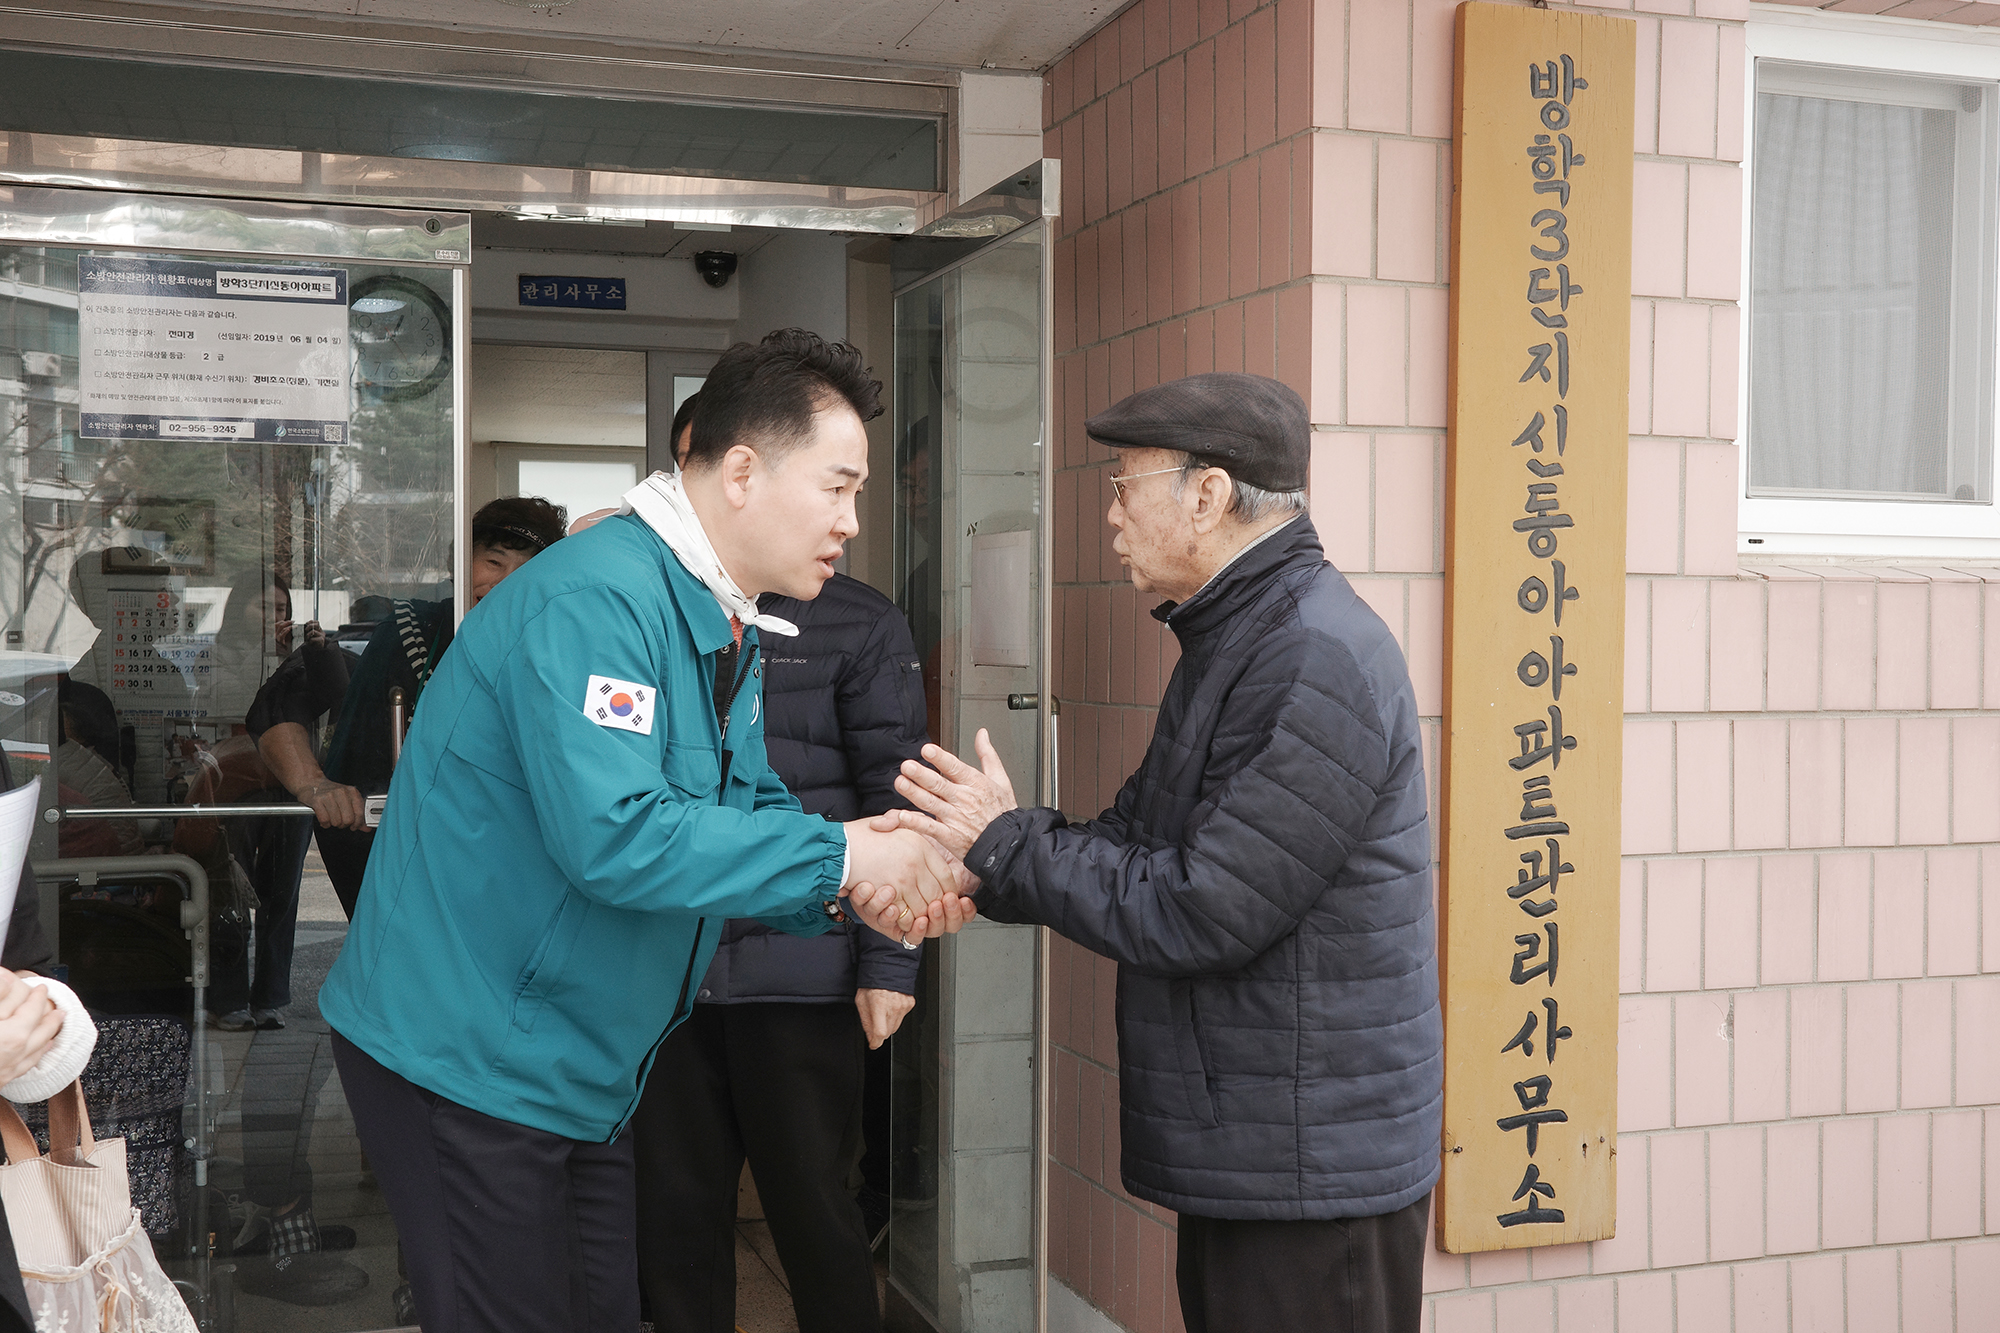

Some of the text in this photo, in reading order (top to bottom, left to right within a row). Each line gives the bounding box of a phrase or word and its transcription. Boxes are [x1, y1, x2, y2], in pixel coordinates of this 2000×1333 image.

[85, 270, 155, 284] 소방안전관리자
[220, 277, 332, 292] 방학3단지신동아아파트
[522, 282, 622, 300] 관리사무소
[86, 305, 237, 319] 이 건축물의 소방안전관리자는 다음과 같습니다.
[103, 327, 341, 345] 소방안전관리자: 전미경 (선임일자: 2019 년 06 월 04 일)
[103, 349, 224, 361] 소방안전관리대상물 등급: 2 급
[103, 371, 154, 380] 소방안전관리자
[155, 372, 170, 380] 근무
[172, 373, 203, 381] 위치(화재
[204, 374, 226, 382] 수신기
[227, 375, 247, 383] 위치):
[88, 422, 134, 431] 소방안전관리자
[135, 423, 157, 431] 연락처:
[169, 423, 236, 433] 02-956-9245
[157, 592, 170, 609] 3
[117, 619, 122, 627] 1
[132, 619, 138, 627] 2
[187, 620, 193, 628] 6
[131, 634, 137, 642] 9
[143, 634, 153, 642] 10
[115, 649, 124, 657] 15
[114, 664, 125, 672] 22
[128, 665, 139, 673] 23
[142, 665, 153, 673] 24
[156, 665, 167, 673] 25
[143, 680, 152, 688] 31
